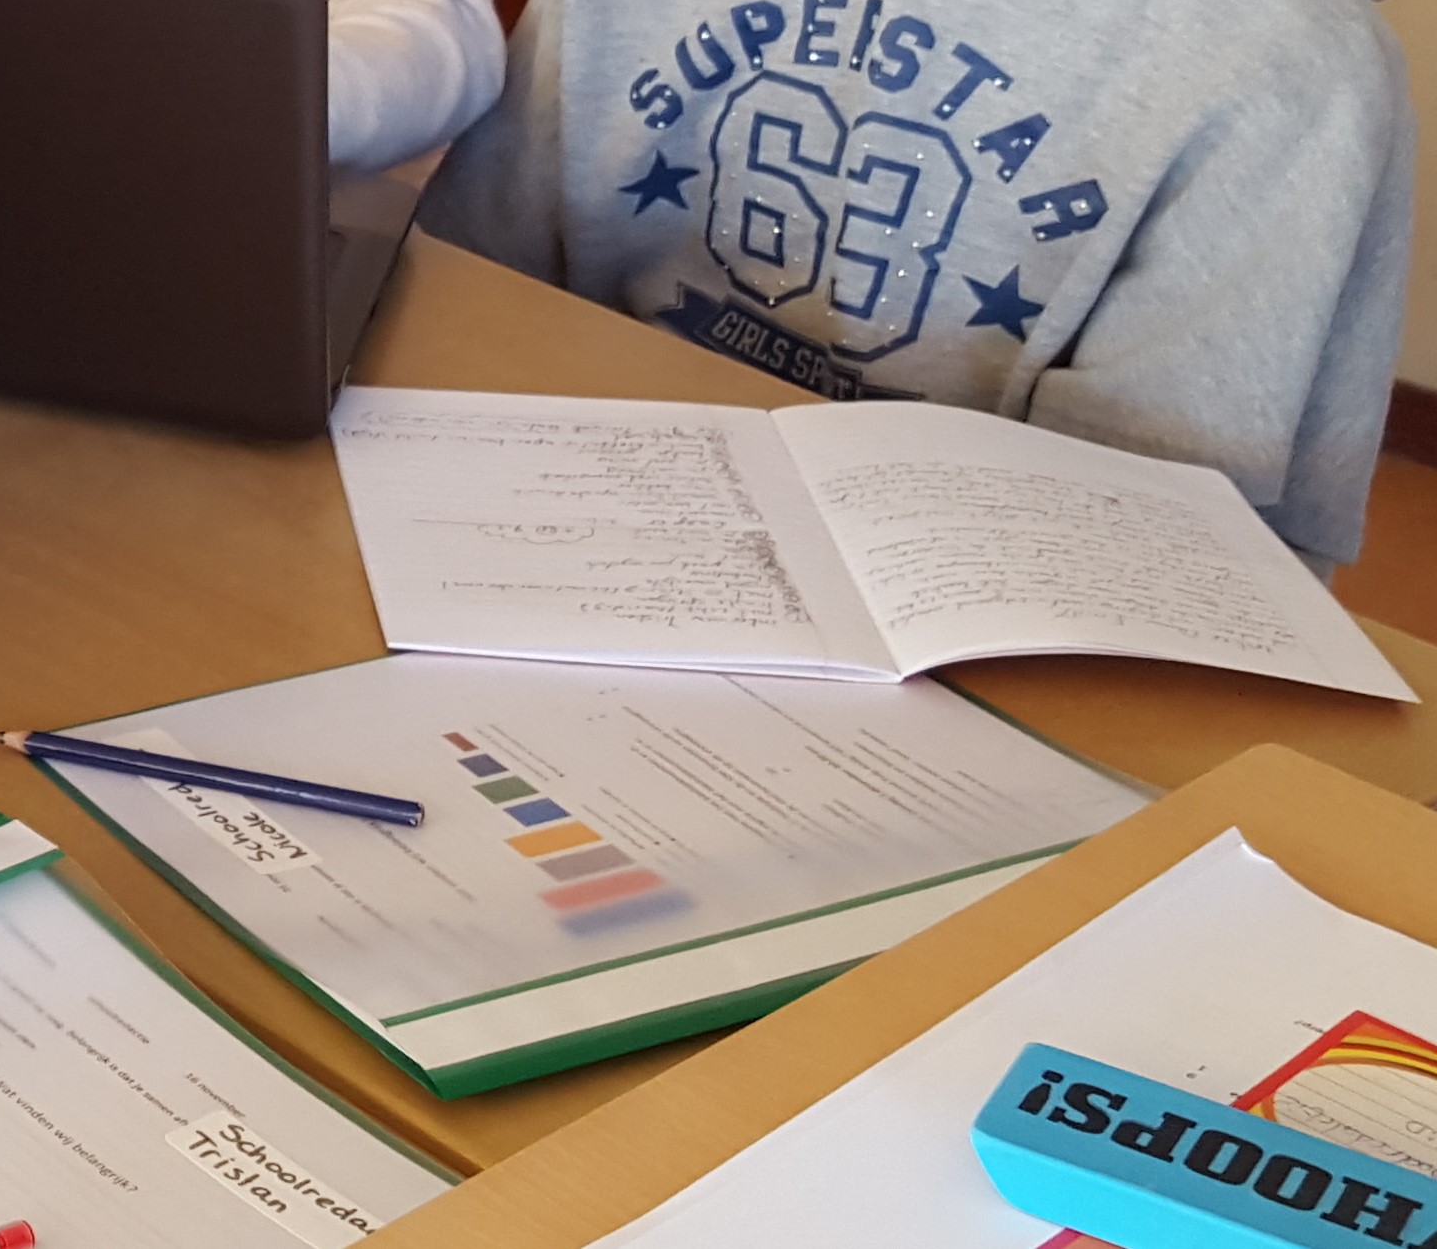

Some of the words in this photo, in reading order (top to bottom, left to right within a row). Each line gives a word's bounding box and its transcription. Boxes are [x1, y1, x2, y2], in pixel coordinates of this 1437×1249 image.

[705, 70, 972, 362] 63
[711, 310, 789, 370] GIRLS
[168, 781, 275, 864] Schoolred
[242, 811, 308, 862] Nicole
[118, 1070, 135, 1085] dat
[131, 1083, 144, 1093] je
[197, 1082, 246, 1120] november
[16, 1097, 54, 1131] vinden
[54, 1129, 75, 1147] wij
[72, 1142, 139, 1194] belangrijk?
[1018, 1069, 1437, 1249] HOOPS!
